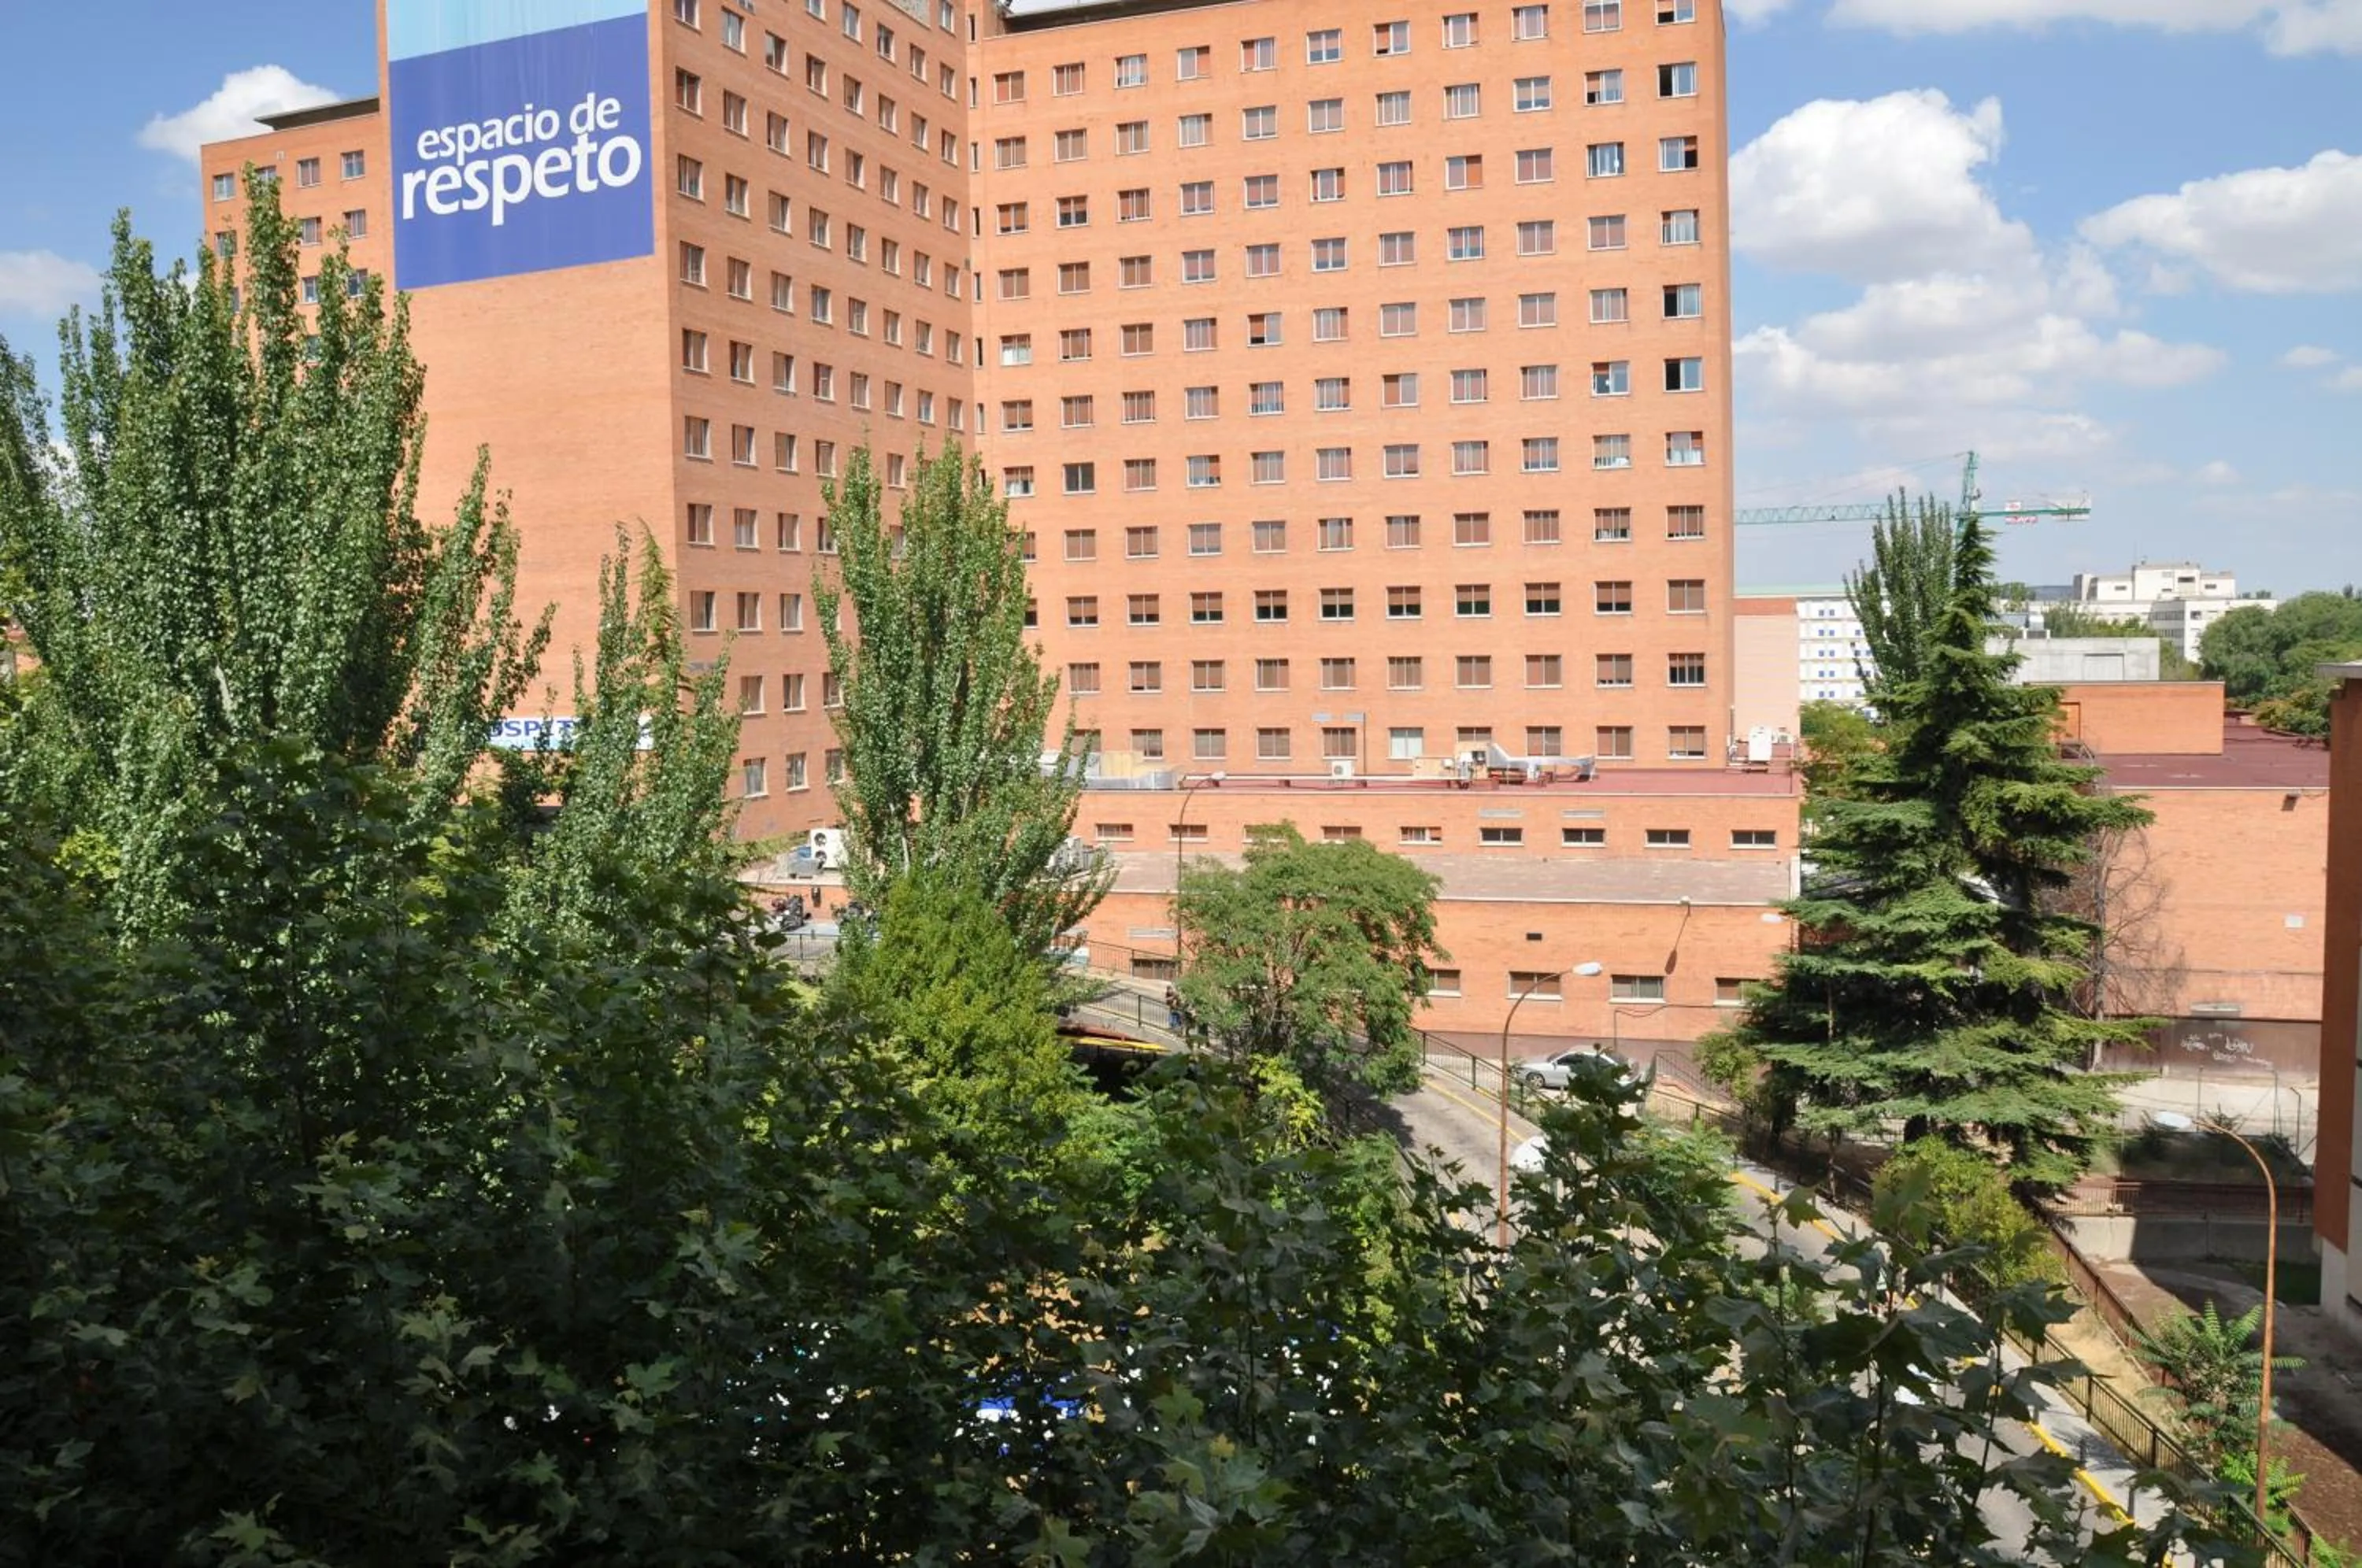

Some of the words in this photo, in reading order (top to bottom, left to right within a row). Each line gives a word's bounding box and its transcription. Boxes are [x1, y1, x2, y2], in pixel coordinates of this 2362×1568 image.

[417, 103, 560, 166] espacio
[569, 92, 621, 134] de
[402, 134, 642, 227] respeto
